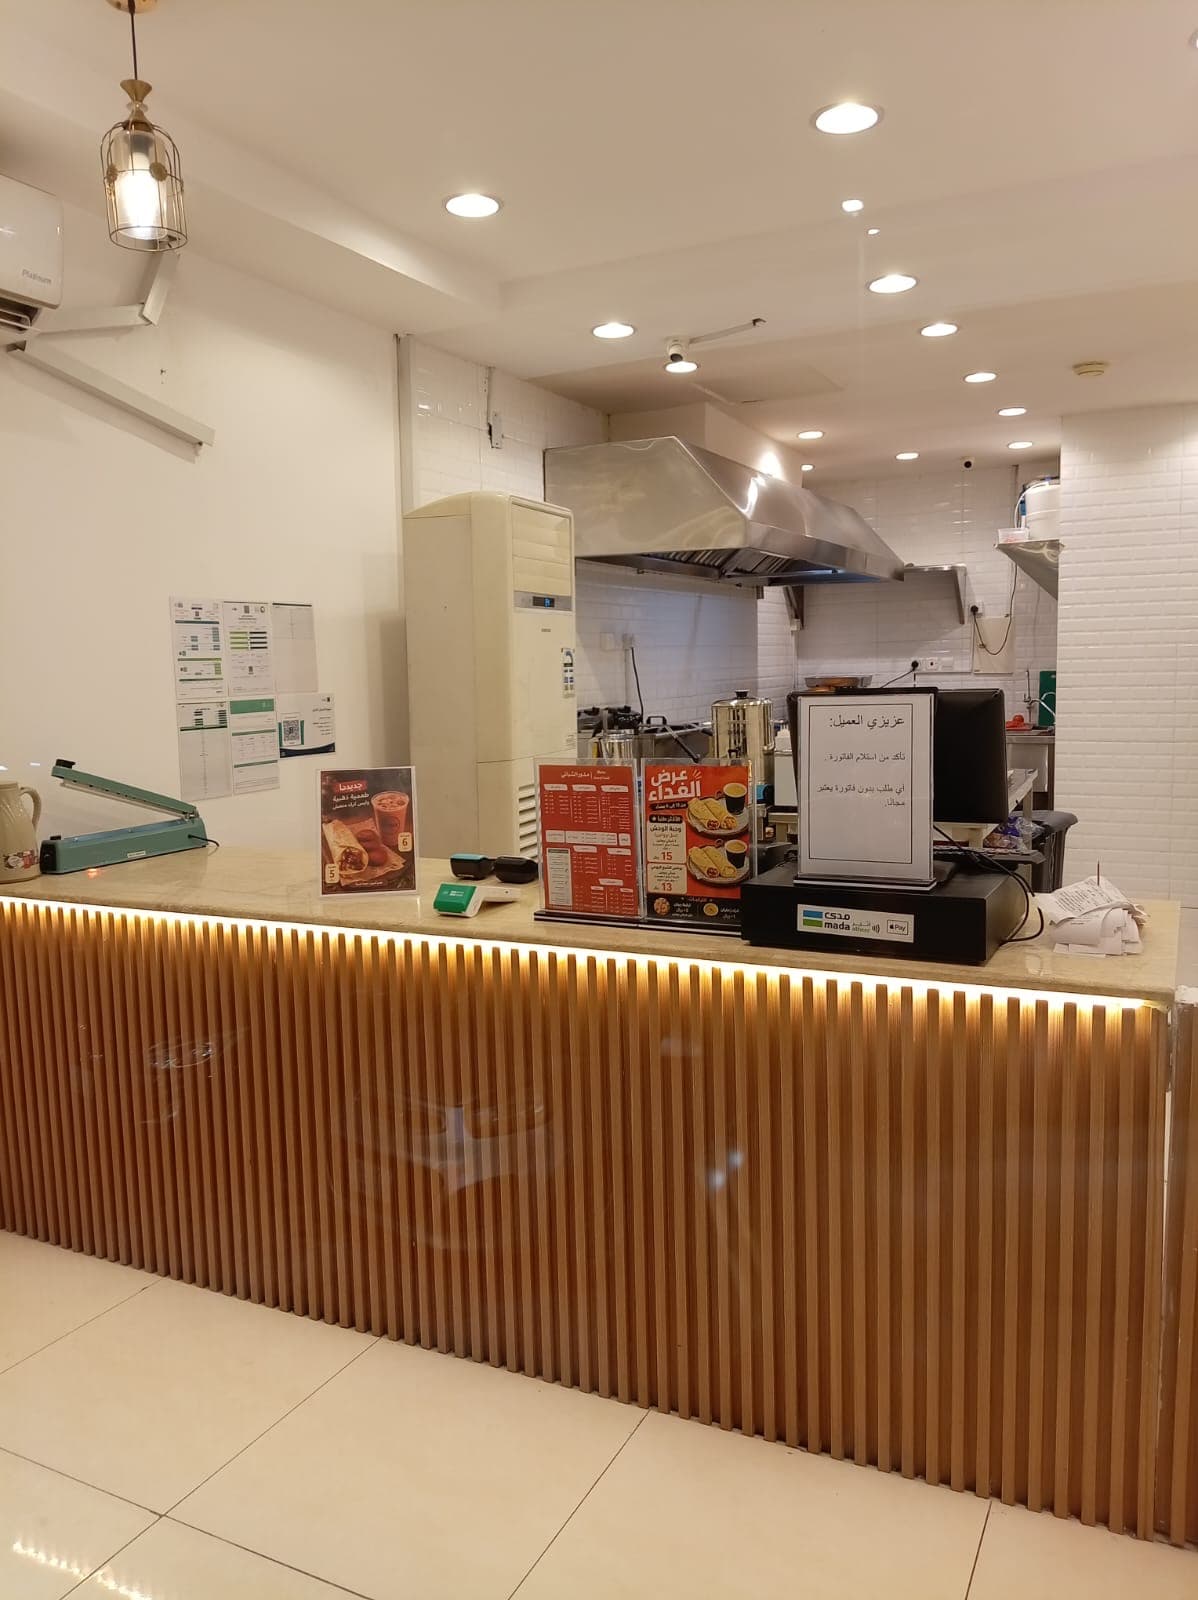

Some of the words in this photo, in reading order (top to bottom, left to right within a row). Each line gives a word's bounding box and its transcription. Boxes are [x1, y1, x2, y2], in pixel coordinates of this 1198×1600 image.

[829, 714, 863, 728] العميل:
[867, 715, 905, 730] عزيزي
[829, 752, 854, 762] الفاتورة
[855, 752, 877, 762] استلام
[879, 754, 889, 762] من
[891, 752, 906, 761] تأكد
[651, 769, 688, 787] عرض
[648, 780, 701, 801] الغداء
[816, 784, 833, 793] يعتبر
[835, 784, 856, 793] فاتورة
[857, 785, 875, 794] بدون
[877, 784, 893, 793] طلب
[895, 784, 905, 795] أي
[402, 837, 408, 847] 6
[661, 851, 672, 860] 15
[329, 869, 335, 878] 5
[661, 882, 672, 891] 13
[824, 921, 851, 931] mada
[894, 924, 906, 932] Pay
